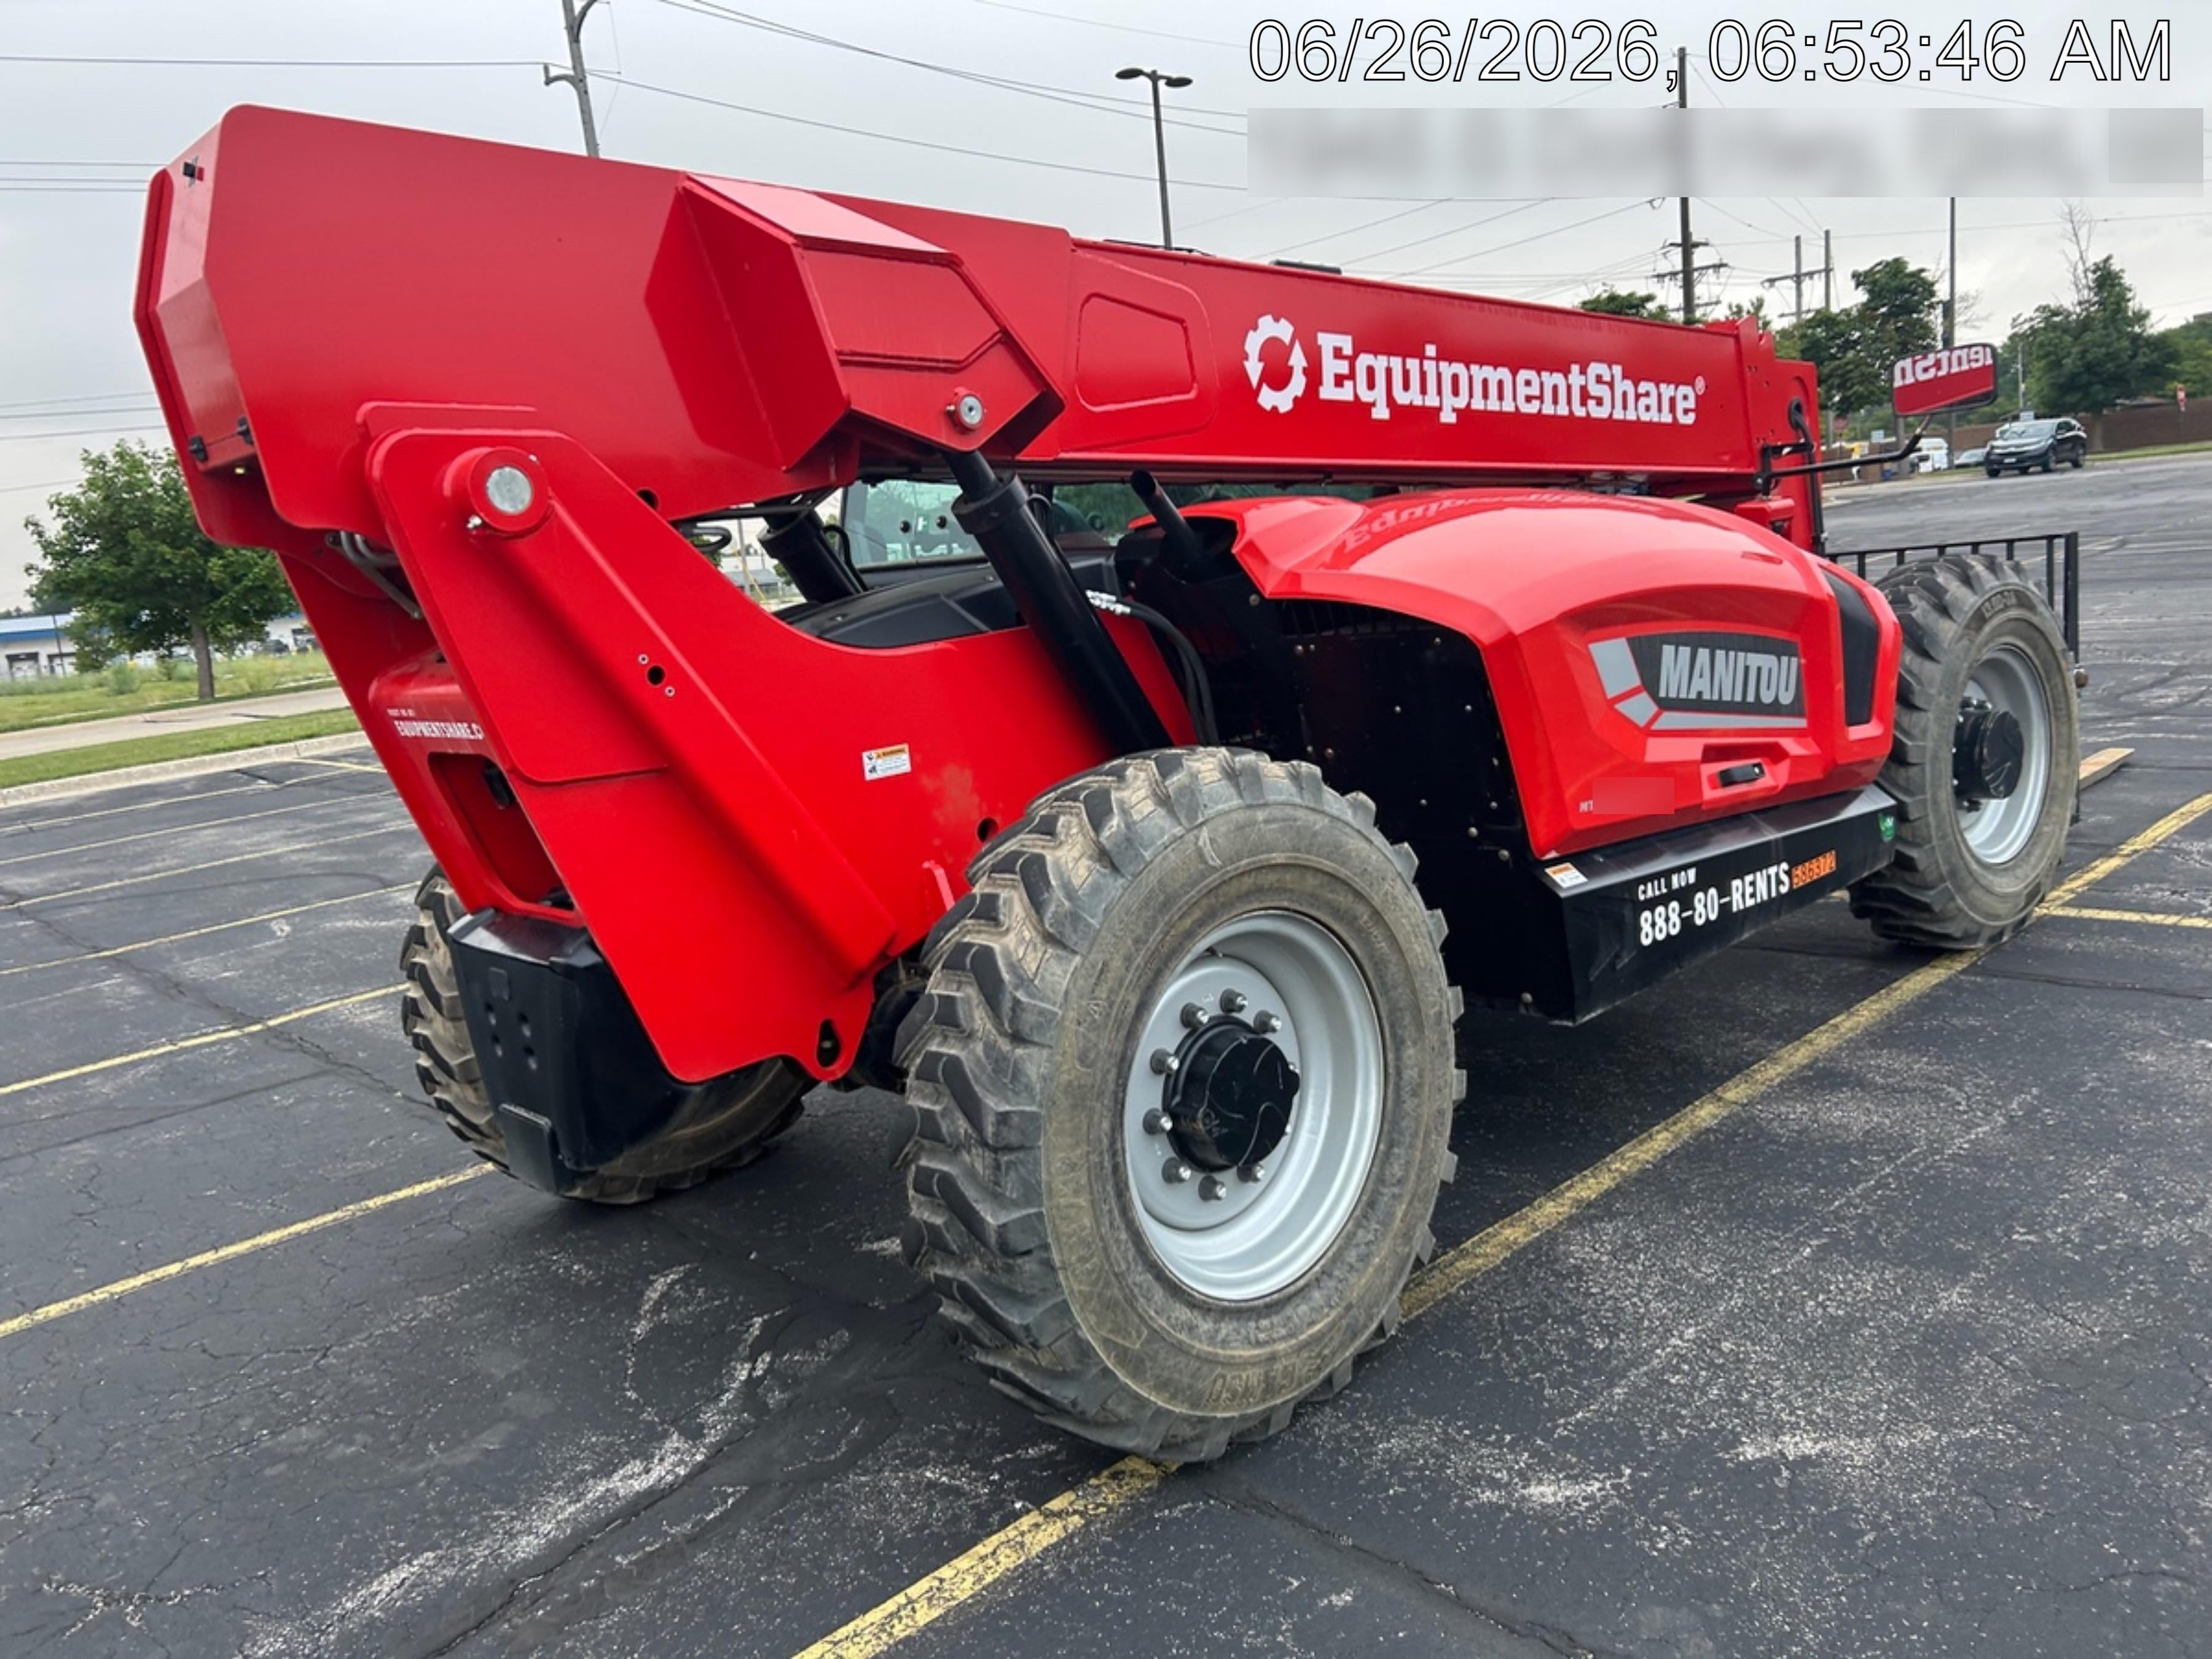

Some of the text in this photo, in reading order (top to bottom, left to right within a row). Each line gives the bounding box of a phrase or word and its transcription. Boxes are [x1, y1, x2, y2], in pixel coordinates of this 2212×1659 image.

[1659, 645, 1798, 705] MANITOU
[1638, 868, 1696, 901] CALL NOW
[1639, 861, 1790, 946] 888-80-RENTS
